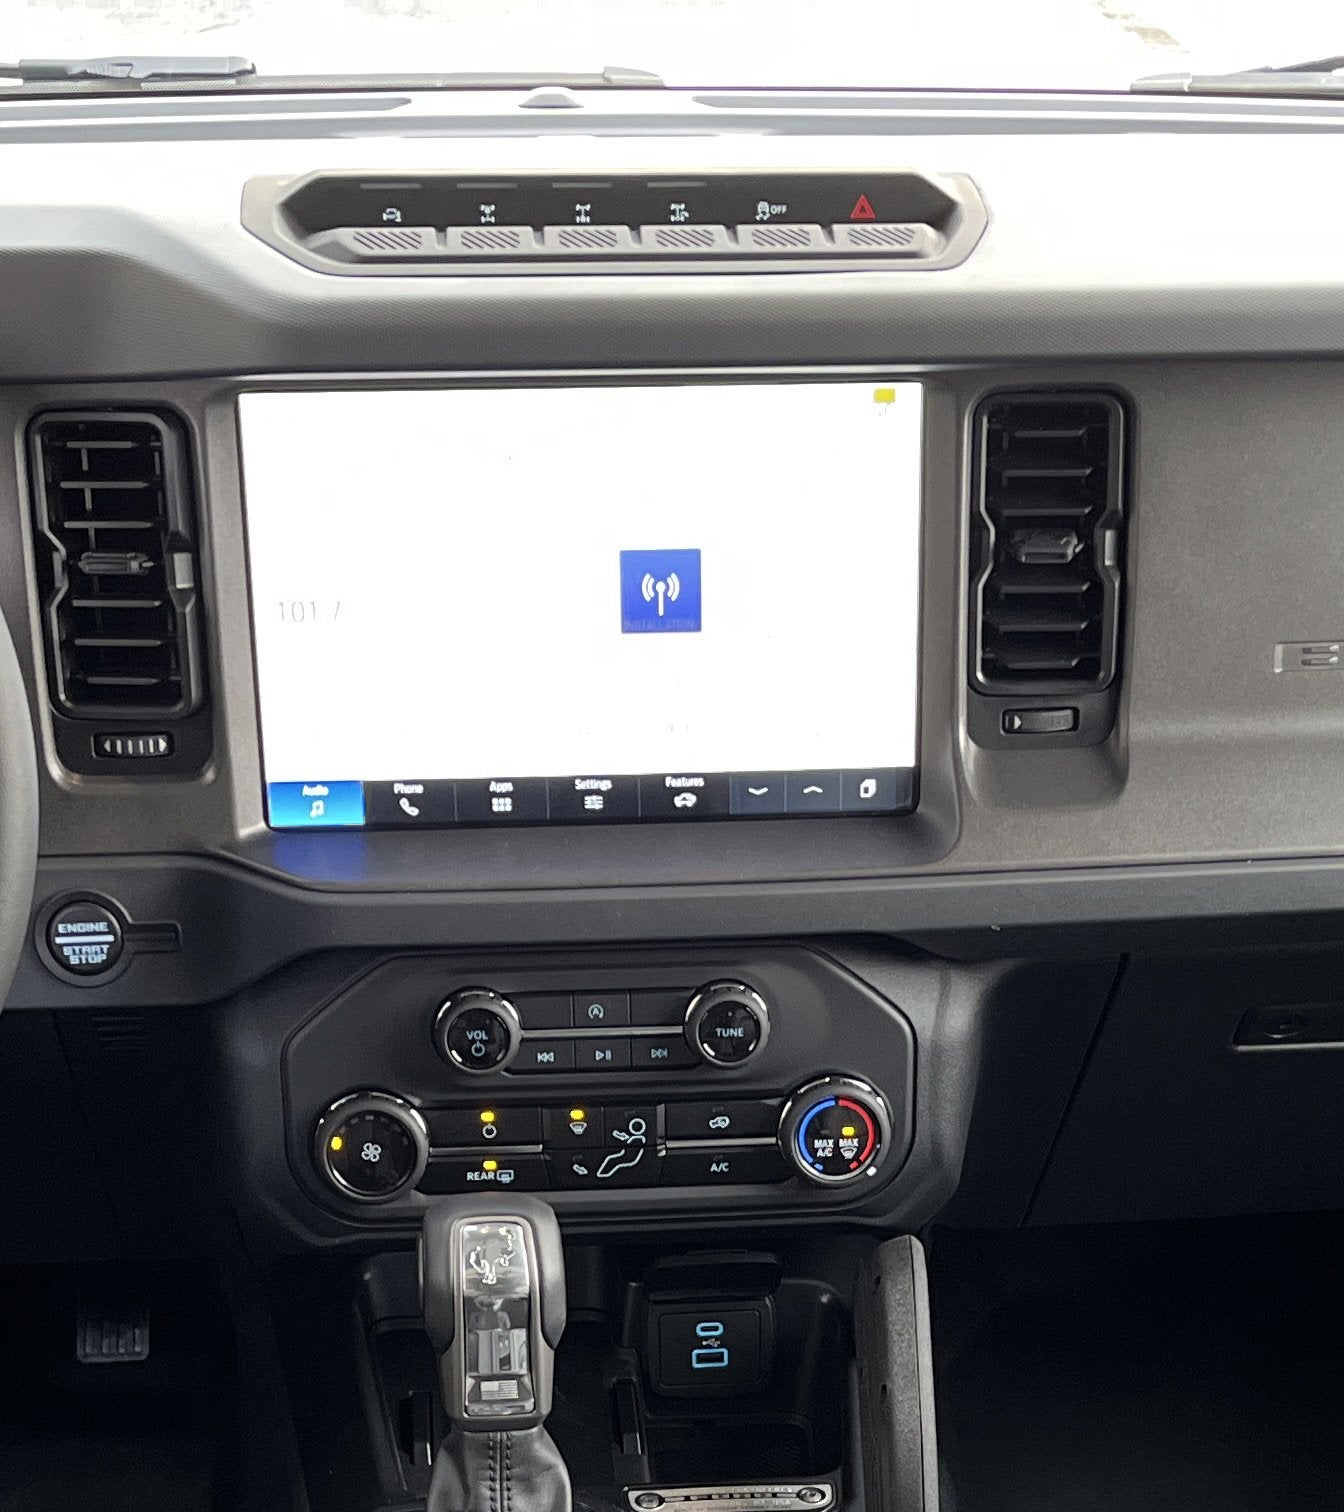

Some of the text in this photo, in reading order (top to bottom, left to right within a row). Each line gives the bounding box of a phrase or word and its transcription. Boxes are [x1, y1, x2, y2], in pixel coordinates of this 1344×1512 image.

[770, 204, 787, 215] OFF
[489, 781, 513, 793] Apps
[574, 778, 612, 791] Settings
[665, 776, 704, 788] Features
[302, 784, 329, 797] Audio
[393, 783, 423, 795] Phone
[57, 921, 110, 934] ENGINE
[62, 944, 110, 956] START
[69, 954, 107, 965] STOP
[466, 1031, 489, 1041] VOL
[715, 1027, 744, 1038] TUNE
[814, 1139, 834, 1148] MAX
[839, 1138, 859, 1148] MAX
[816, 1148, 833, 1157] A/C
[710, 1162, 730, 1173] A/C
[466, 1170, 495, 1182] REAR
